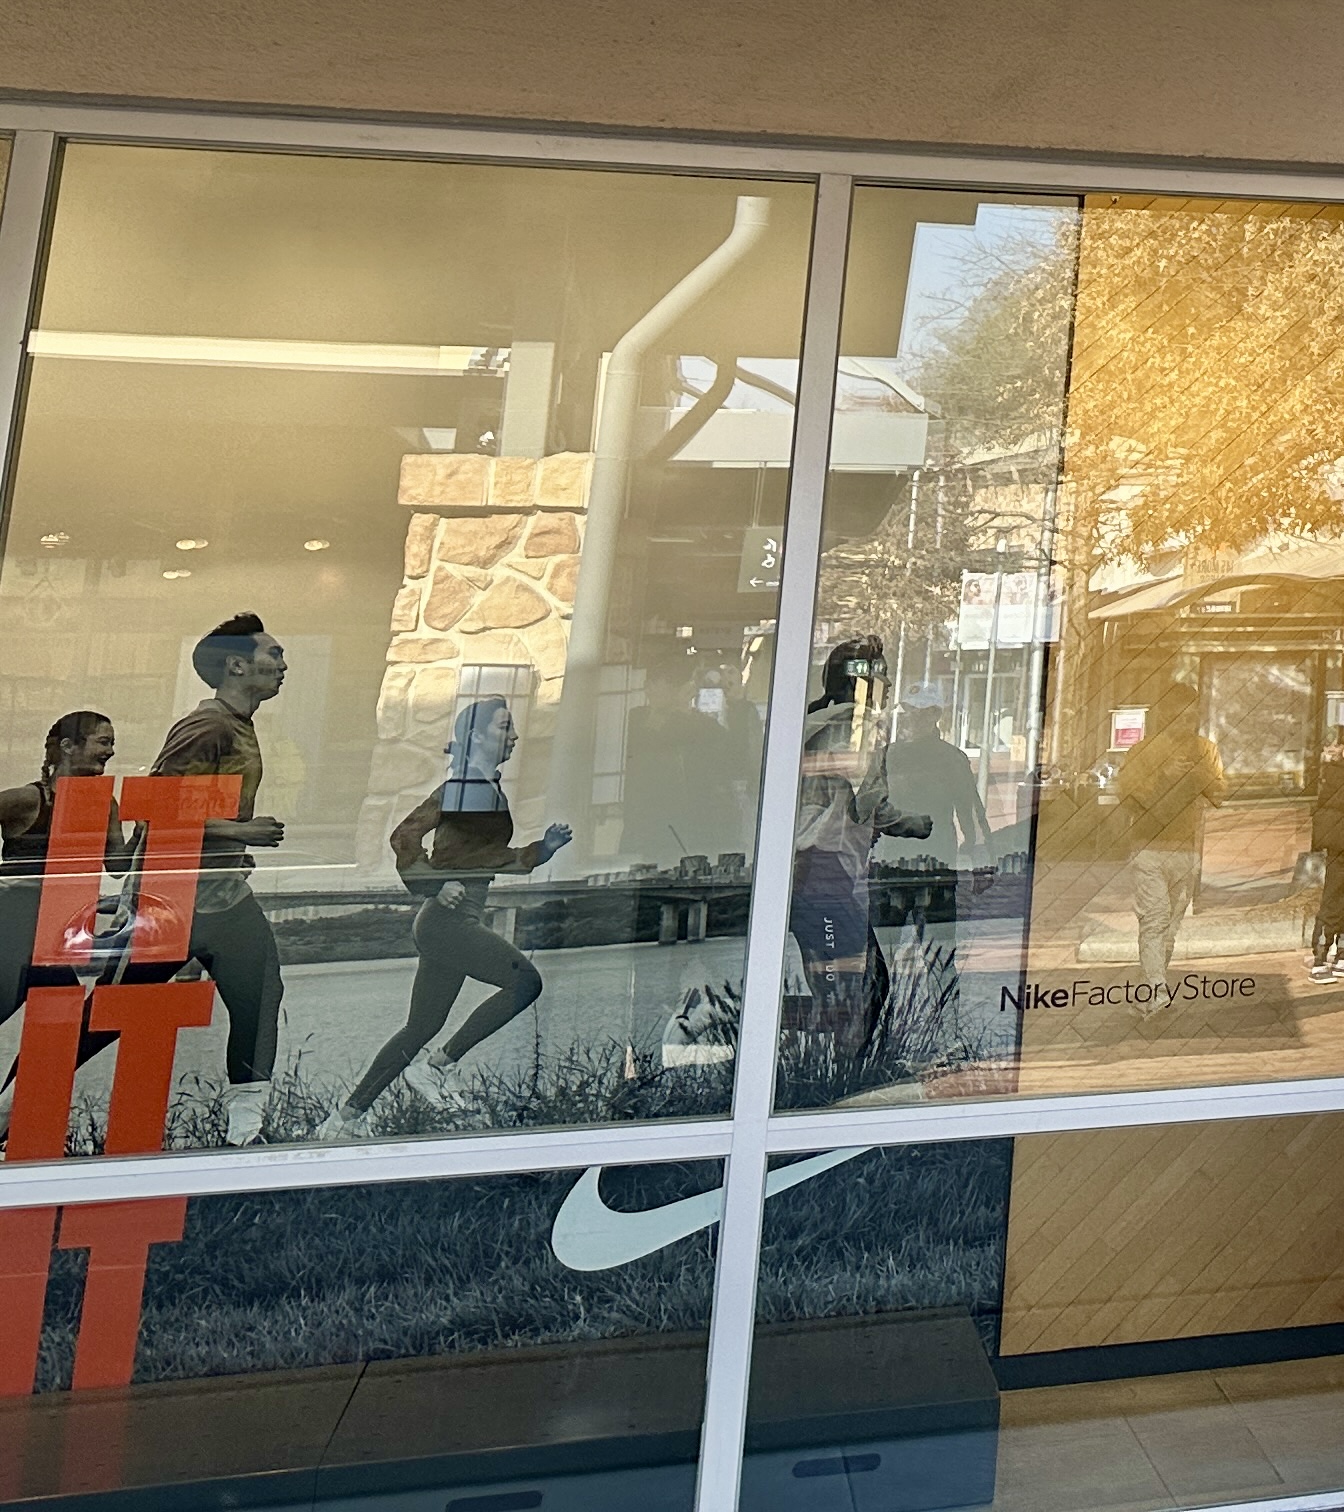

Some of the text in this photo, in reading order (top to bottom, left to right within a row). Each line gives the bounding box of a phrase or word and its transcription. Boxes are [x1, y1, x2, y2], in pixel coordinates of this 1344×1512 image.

[32, 774, 243, 966] IT
[823, 917, 835, 949] JUST
[5, 981, 216, 1162] IT
[999, 973, 1256, 1012] NikeFactoryStore
[0, 1196, 188, 1395] IT
